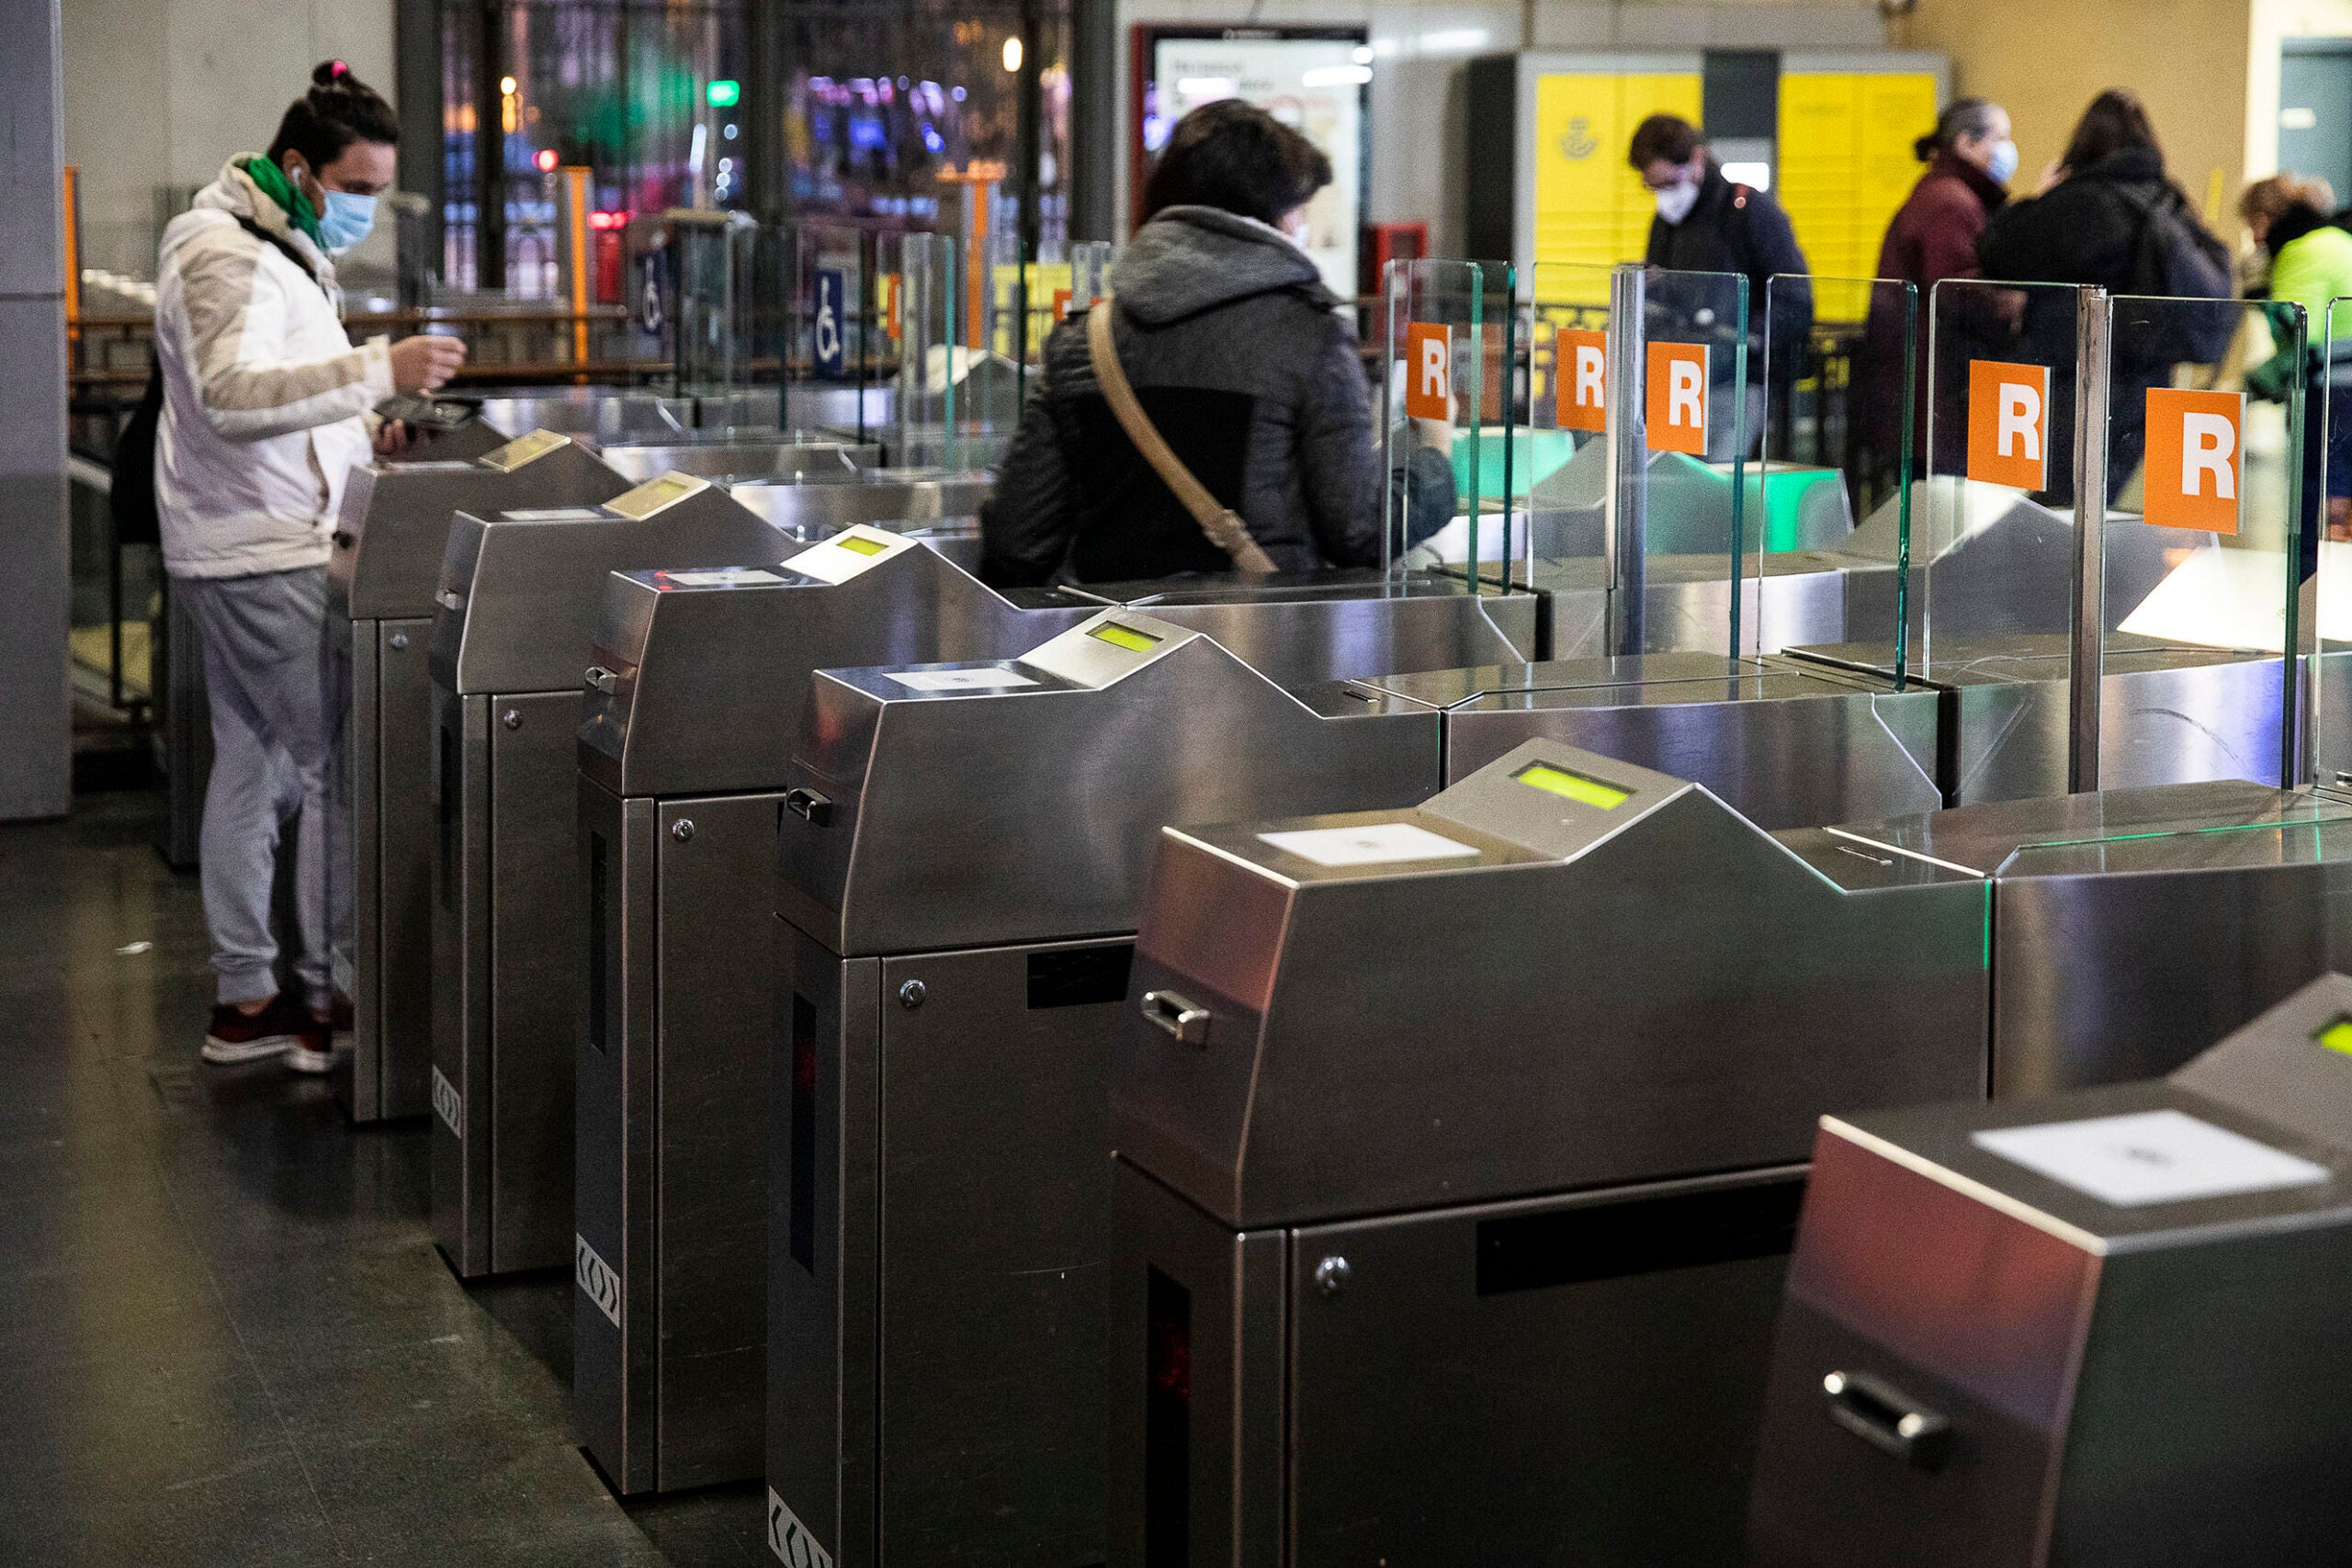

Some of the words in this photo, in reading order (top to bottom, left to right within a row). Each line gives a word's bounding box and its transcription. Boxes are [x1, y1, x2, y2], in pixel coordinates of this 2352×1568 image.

[1422, 339, 1446, 398] R
[1577, 346, 1606, 409] R
[1669, 360, 1702, 428] R
[1998, 383, 2041, 460] R
[2182, 412, 2235, 499] R
